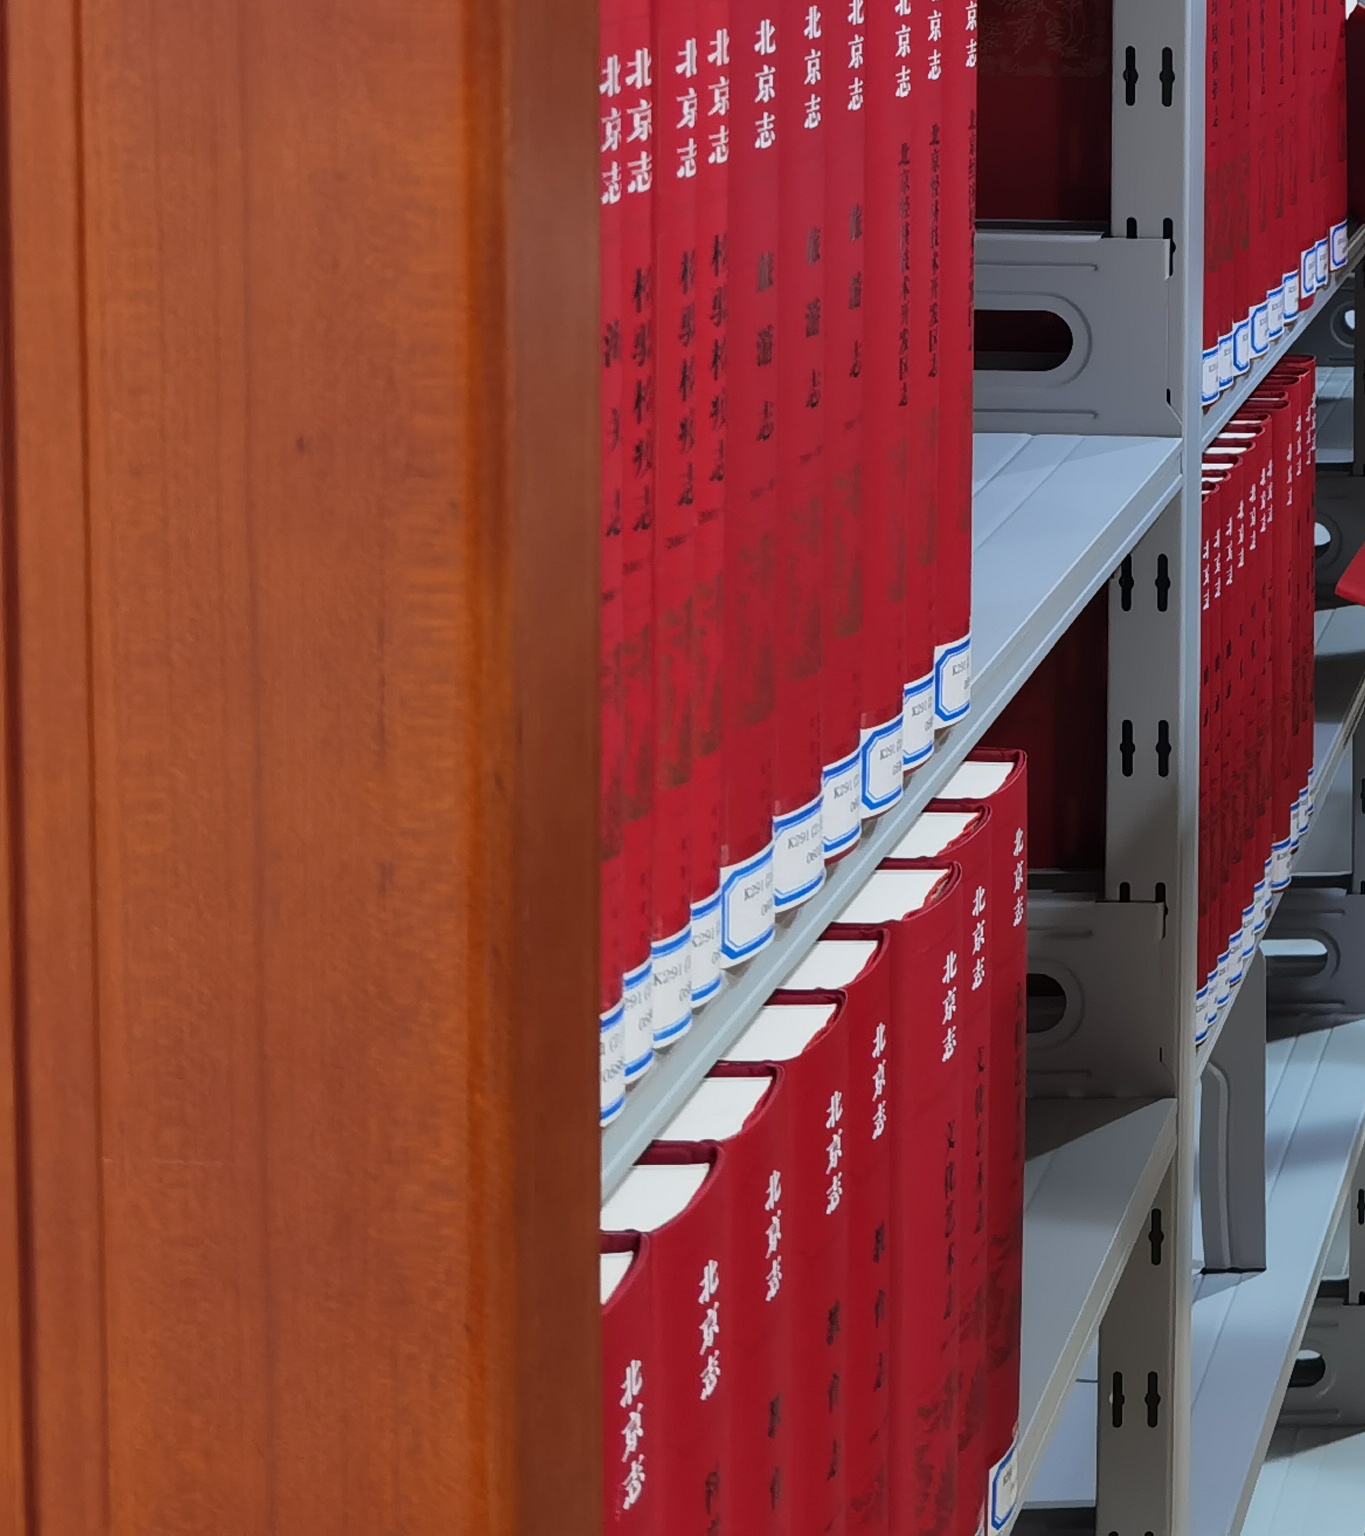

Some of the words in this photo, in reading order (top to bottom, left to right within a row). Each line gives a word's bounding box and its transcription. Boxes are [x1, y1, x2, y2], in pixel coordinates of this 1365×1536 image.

[599, 54, 622, 205] 北京志
[625, 47, 653, 194] 北京志
[675, 37, 698, 179] 北京志
[707, 28, 730, 164] 北京志
[754, 18, 777, 149] 北京志
[803, 5, 822, 129] 北京志
[971, 885, 986, 991] 北京志
[941, 950, 958, 1063] 北京志
[871, 1022, 887, 1140] 北京志
[825, 1090, 844, 1215] 北京志
[764, 1169, 783, 1302] 北京志
[698, 1259, 721, 1401] 北京志
[619, 1359, 646, 1510] 北京志
